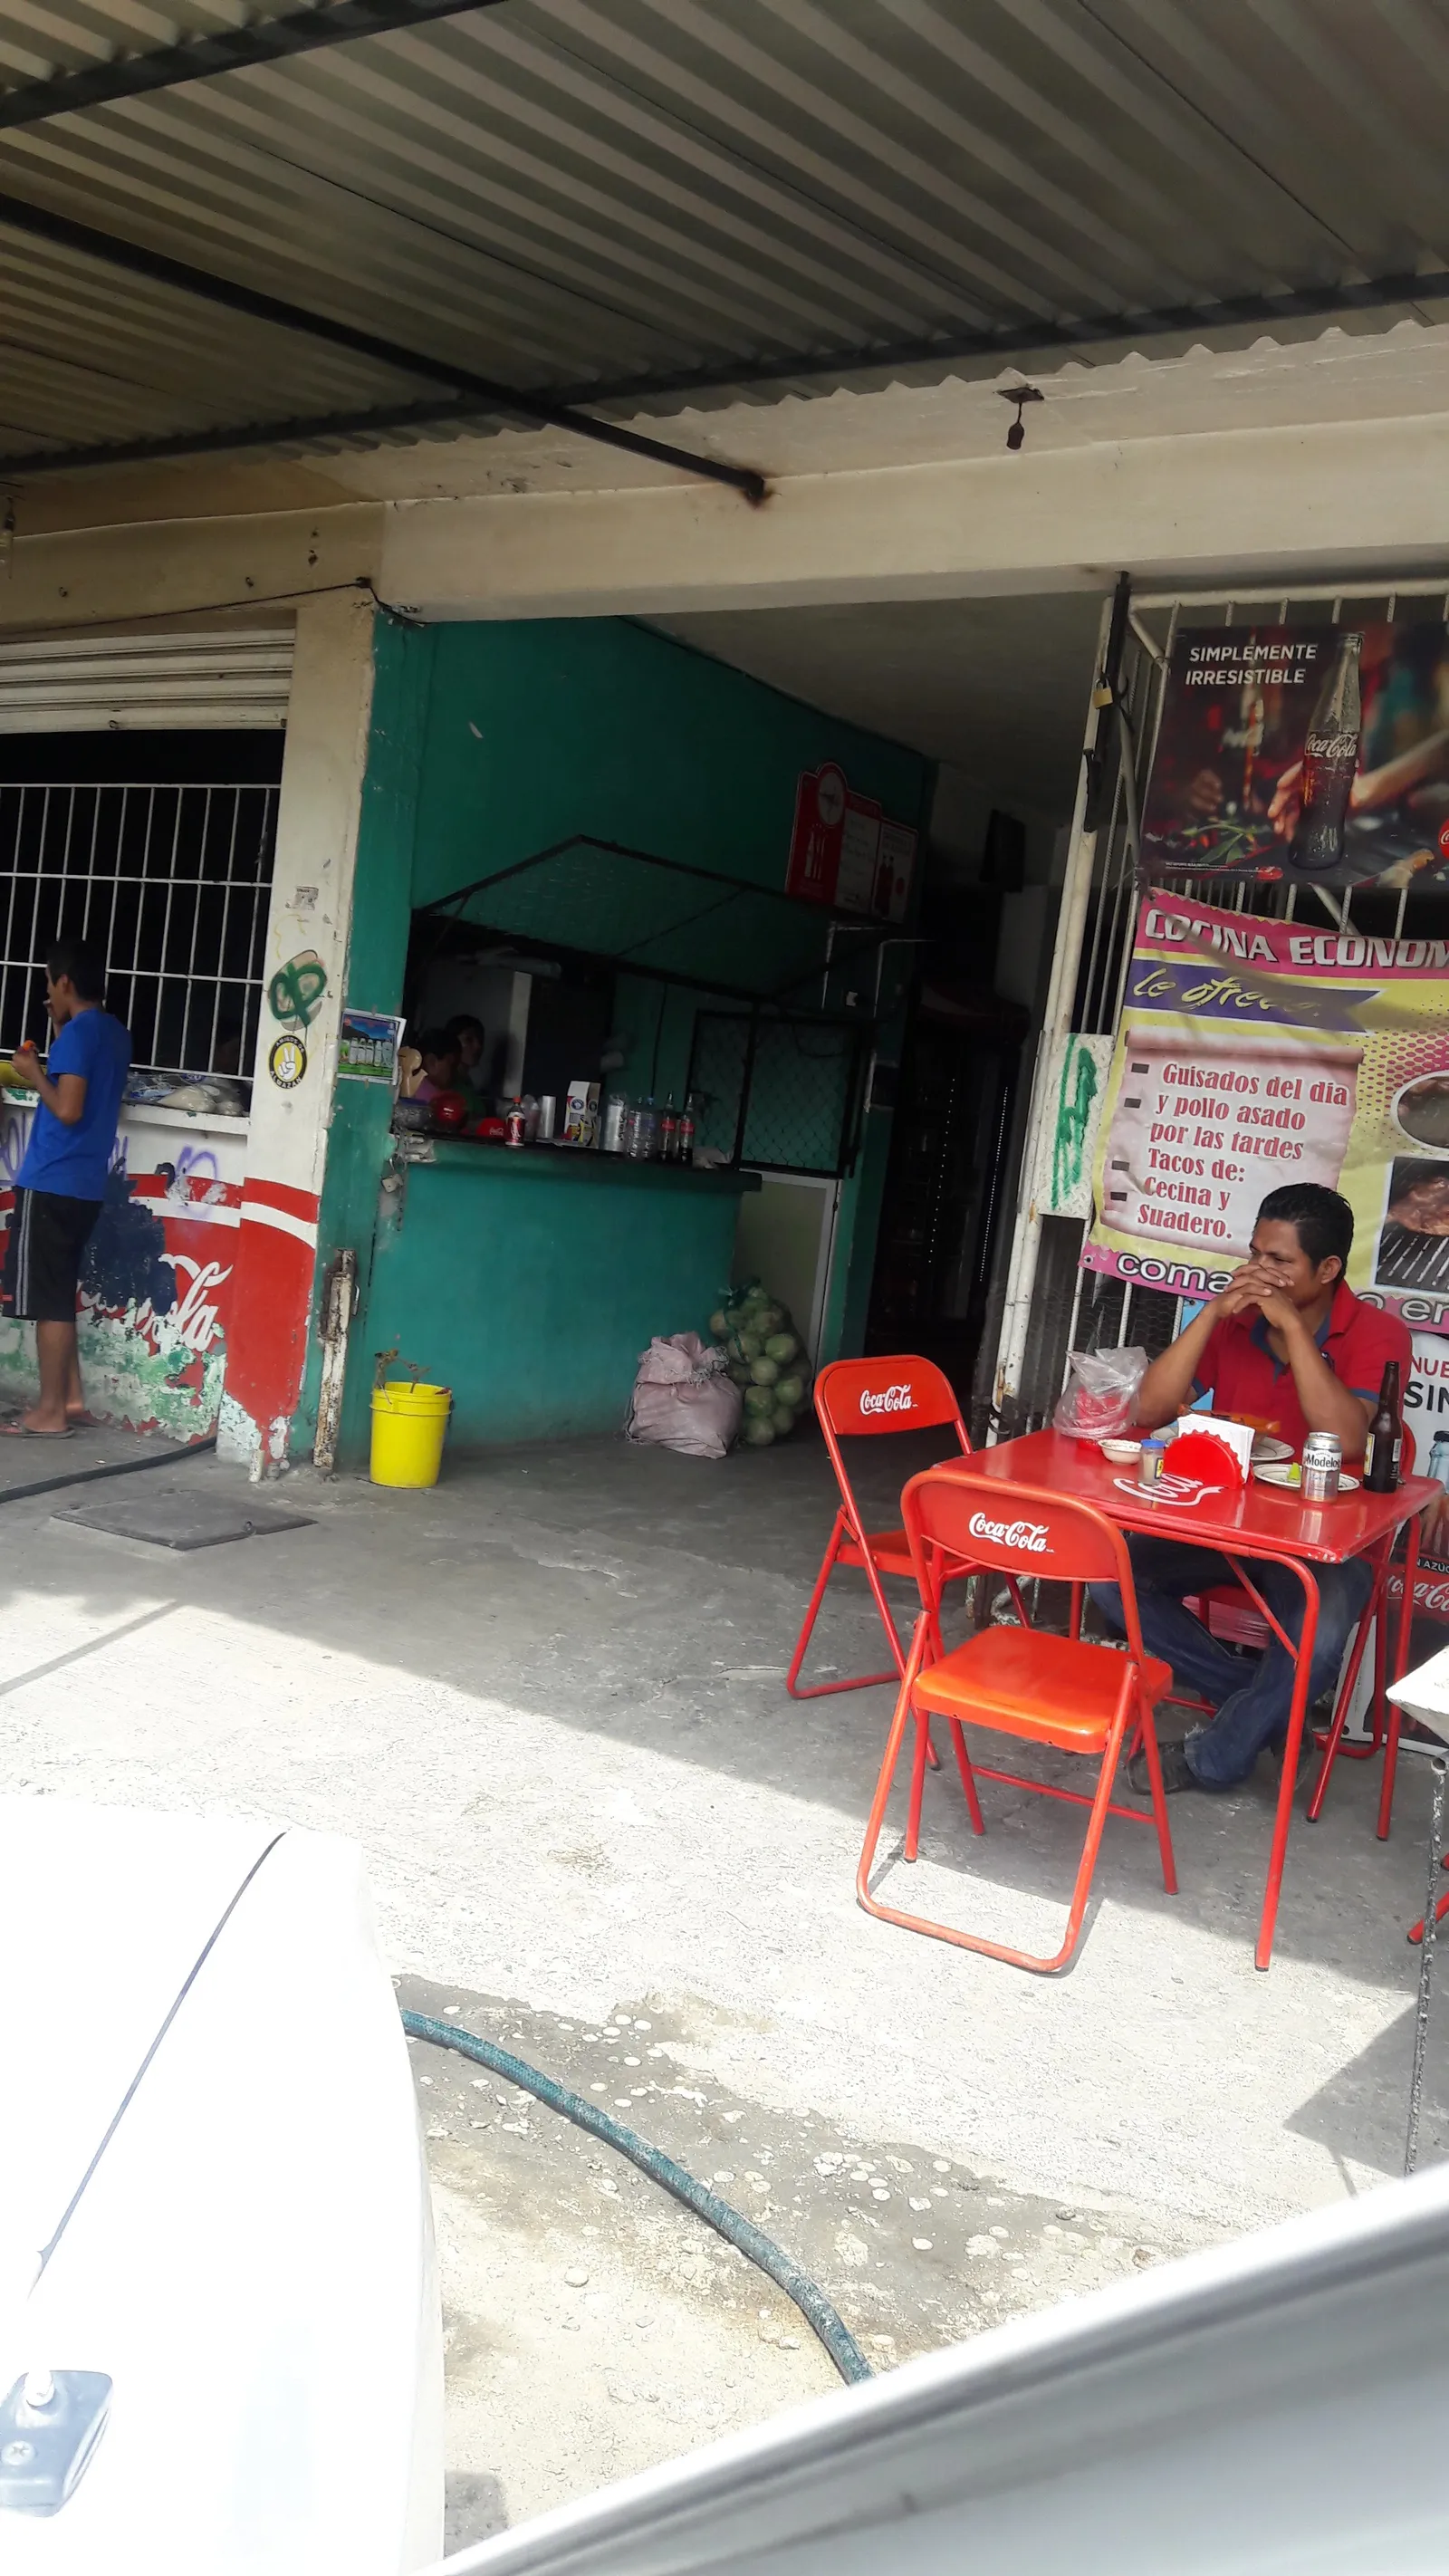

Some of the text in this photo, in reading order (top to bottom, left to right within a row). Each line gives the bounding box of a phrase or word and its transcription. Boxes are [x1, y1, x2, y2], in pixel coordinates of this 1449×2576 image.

[1189, 643, 1318, 662] SIMPLEMENTE
[1185, 668, 1306, 686] IRRESISTIBLE
[1304, 732, 1358, 758] Coca-Cola
[1145, 908, 1279, 962] COCINA
[1163, 1063, 1260, 1095] Guisados
[1266, 1076, 1302, 1100] del
[1156, 1095, 1306, 1129] y pollo asado
[1150, 1122, 1304, 1159] por las tardes
[1148, 1148, 1245, 1182] Tacos de:
[1144, 1177, 1231, 1211] Cecina y
[1137, 1204, 1233, 1239] Suadero.
[860, 1384, 912, 1415] Coca-Cola
[969, 1512, 1049, 1552] Coca-Cola
